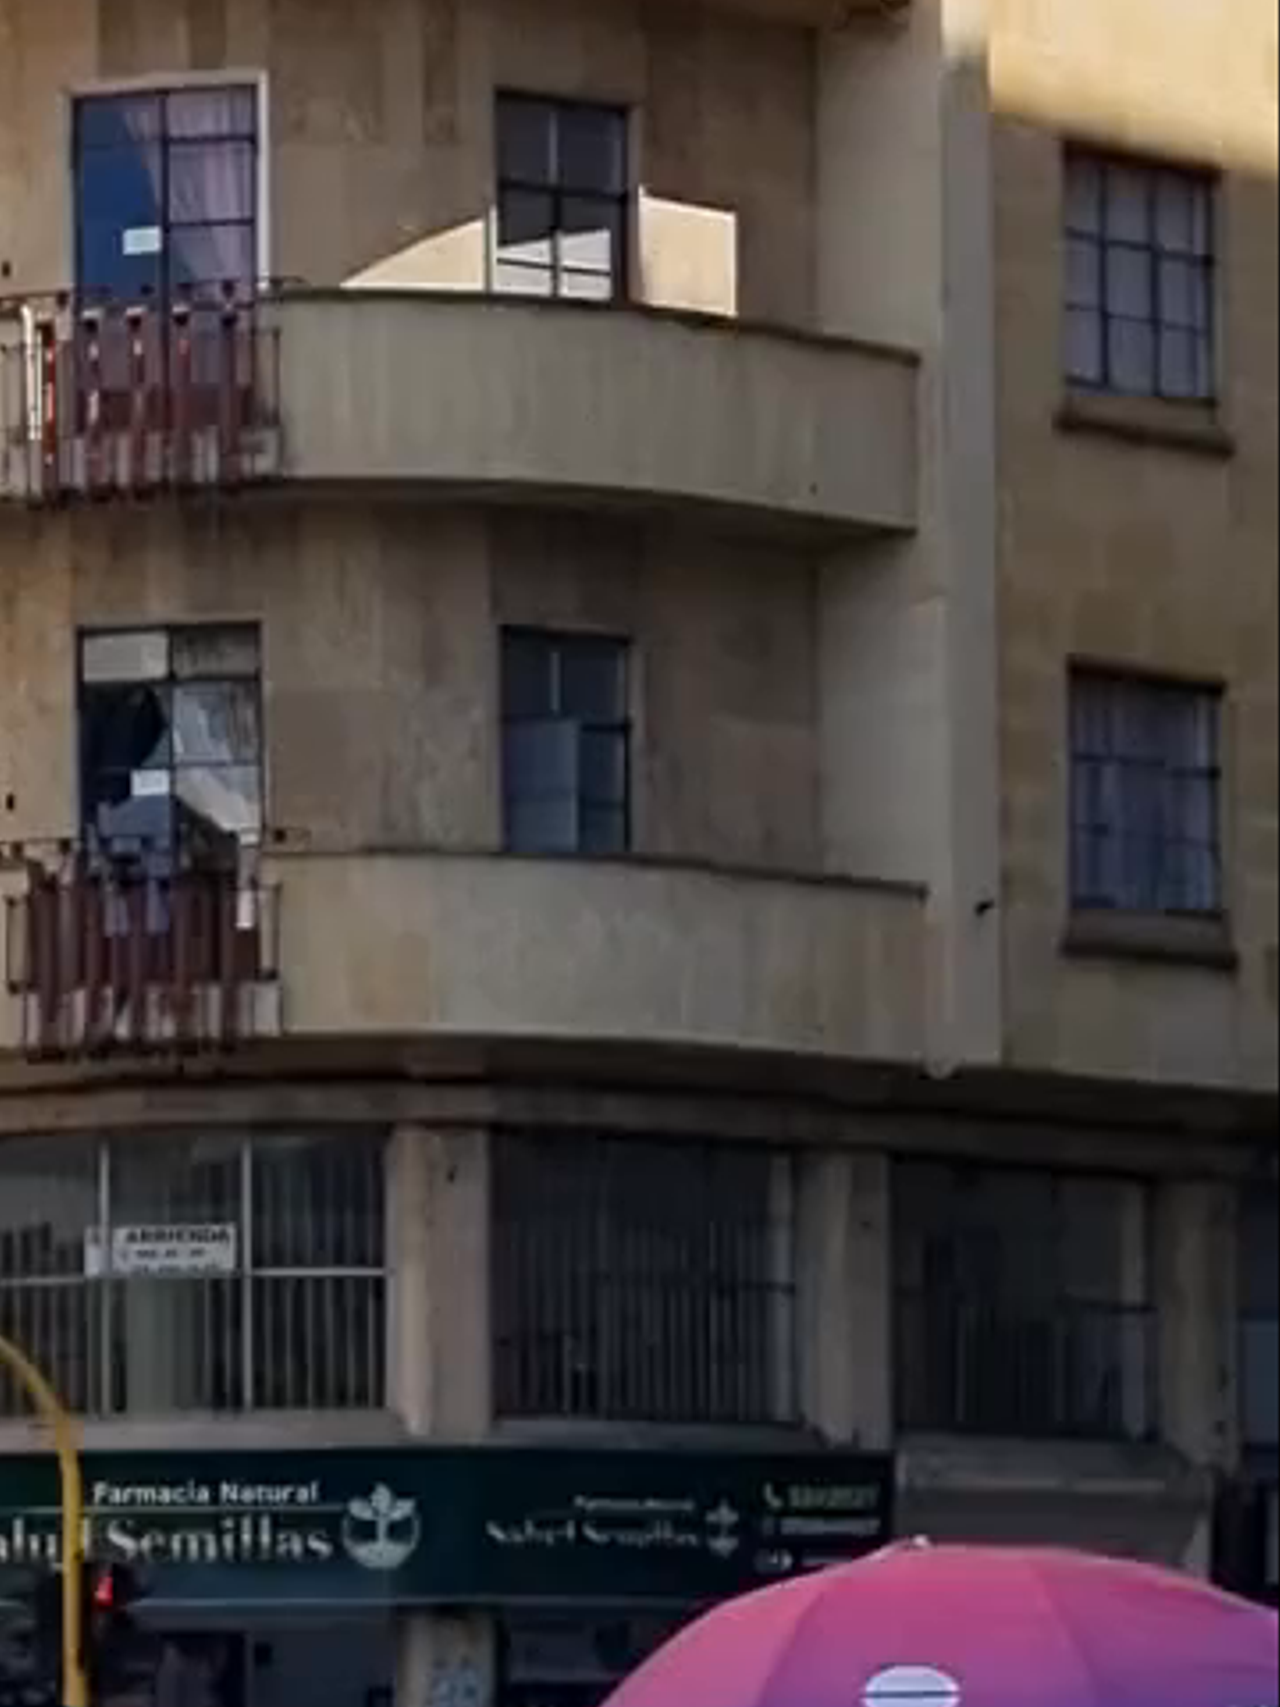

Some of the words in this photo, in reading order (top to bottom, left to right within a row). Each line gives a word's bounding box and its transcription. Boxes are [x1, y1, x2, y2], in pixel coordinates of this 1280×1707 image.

[92, 1481, 210, 1505] Farmacia
[219, 1480, 320, 1505] Natural
[106, 1514, 334, 1564] Semillas
